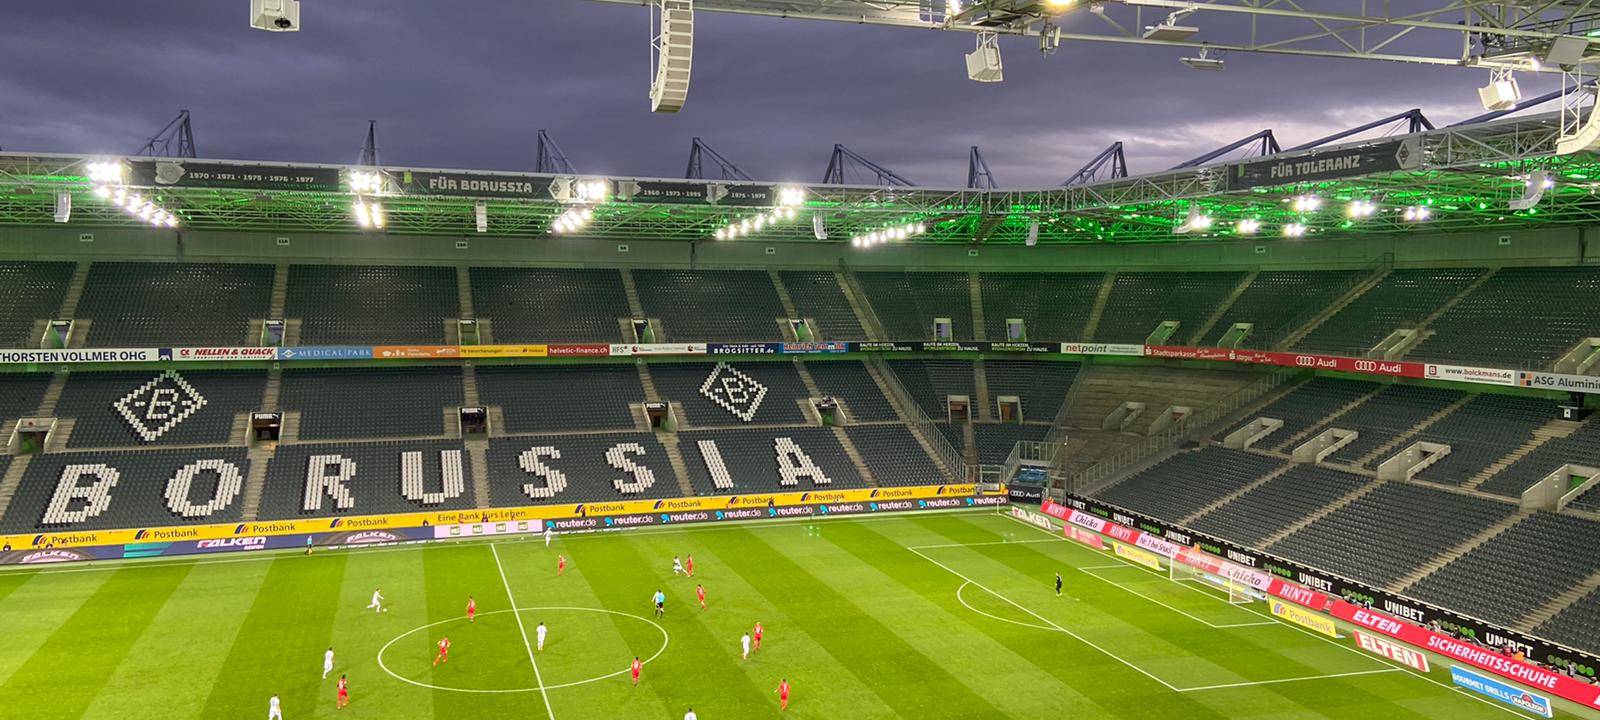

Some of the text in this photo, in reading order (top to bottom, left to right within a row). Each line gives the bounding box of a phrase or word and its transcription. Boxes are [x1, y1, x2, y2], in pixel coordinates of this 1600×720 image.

[1271, 155, 1360, 178] FÜR TOLERANZ
[429, 176, 532, 193] FÜR BORUSSIA
[195, 348, 230, 356] NELLEN
[231, 348, 238, 356] &
[1066, 344, 1107, 353] netpoint
[1153, 349, 1196, 358] Stadtsparkasse
[61, 351, 117, 361] VOLLMER
[120, 351, 147, 361] OHG
[1317, 358, 1337, 367] Audi
[1379, 363, 1401, 373] Audi
[1445, 367, 1512, 379] www.bolckmans.de
[1534, 376, 1600, 389] ASG Alumini
[42, 438, 832, 524] BORUSSIA
[883, 489, 912, 497] Postbank
[949, 486, 976, 494] Postban
[814, 493, 845, 501] Postbank
[928, 497, 961, 507] reuter.de
[973, 496, 1007, 505] reuter.de
[590, 503, 625, 513] Postbank
[668, 501, 702, 509] Postbank
[828, 504, 864, 513] reuter.de
[878, 500, 913, 510] reuter.de
[724, 508, 762, 518] reuter.de
[777, 506, 814, 515] reuter.de
[437, 514, 456, 522] Eine
[613, 515, 654, 525] reuter.de
[670, 512, 709, 522] reuter.de
[1011, 506, 1051, 530] FALKEN
[1075, 513, 1098, 529] Chicko
[1113, 512, 1135, 526] UNIBET
[347, 518, 388, 527] Postbank
[555, 520, 597, 529] reuter.de
[154, 528, 198, 538] Postbank
[253, 524, 295, 533] Postbank
[52, 534, 97, 543] Postbank
[346, 531, 396, 543] FALKEN
[197, 537, 266, 548] FALKEN
[20, 551, 79, 562] FALKEN
[1227, 549, 1256, 567] UNIBET
[1299, 572, 1333, 592] UNIBET
[1280, 583, 1314, 605] RINTI
[1384, 600, 1425, 622] UNIBET
[1290, 609, 1332, 635] Postbank
[1353, 610, 1402, 635] ELTEN
[1358, 632, 1421, 670] ELTEN
[1428, 635, 1558, 689] SICHERHEITSSCHUHE
[1452, 673, 1484, 690] GOURMET
